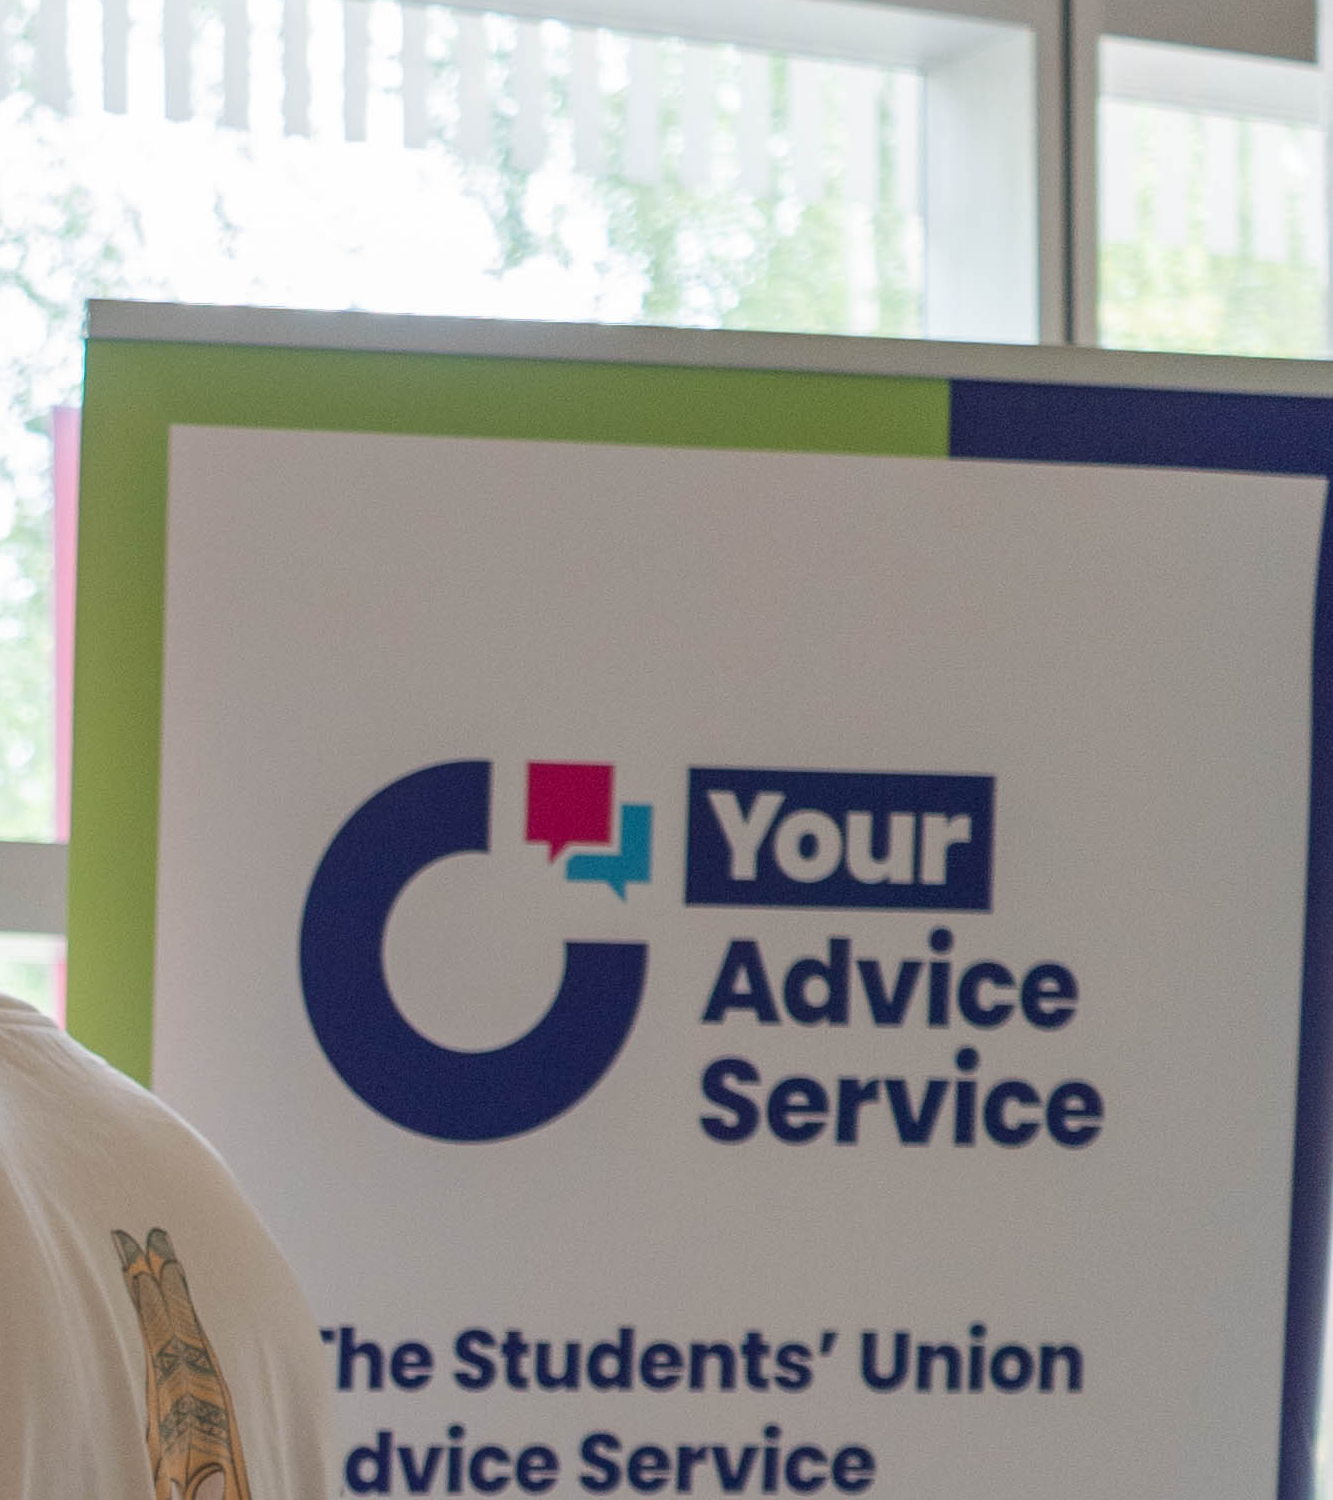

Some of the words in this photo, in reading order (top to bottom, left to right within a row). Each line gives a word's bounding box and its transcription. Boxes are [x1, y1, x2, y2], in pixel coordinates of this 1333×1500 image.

[708, 790, 971, 885] Your
[702, 928, 1078, 1030] Advice
[700, 1047, 1104, 1149] Service
[320, 1326, 434, 1391] he
[861, 1324, 1083, 1393] Union
[345, 1424, 559, 1495] dvice
[579, 1425, 876, 1494] Service
